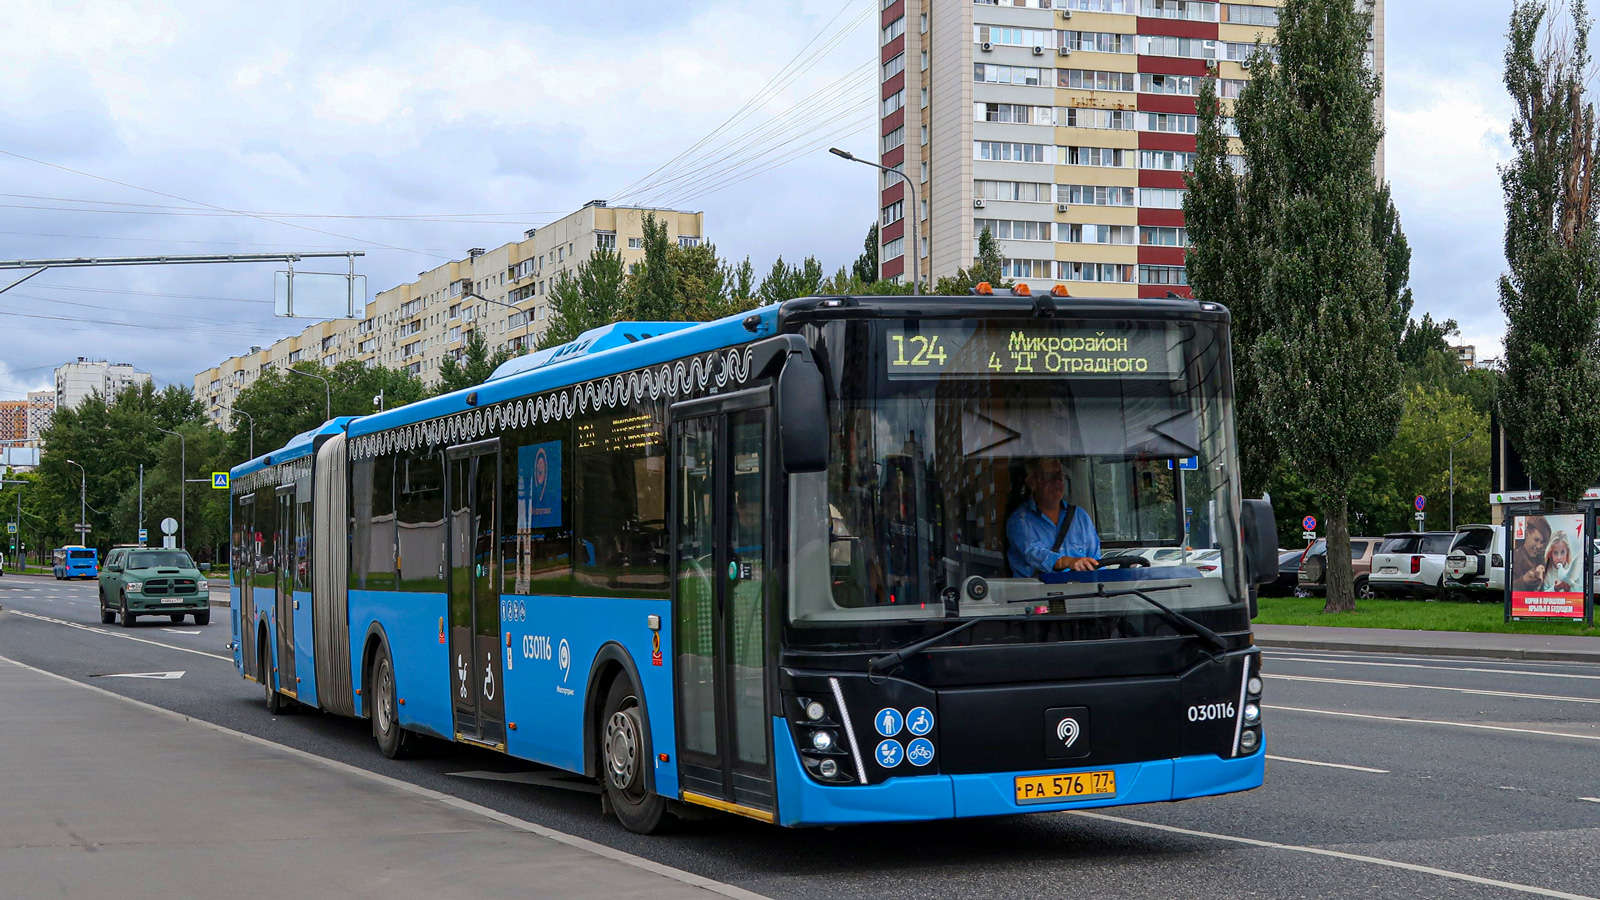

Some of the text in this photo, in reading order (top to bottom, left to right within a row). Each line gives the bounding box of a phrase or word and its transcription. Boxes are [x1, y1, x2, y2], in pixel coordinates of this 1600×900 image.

[892, 334, 948, 366] 124
[1008, 331, 1128, 352] Микрорайон
[988, 351, 1148, 373] 4 "Д" Отрадного
[523, 635, 551, 660] 030116
[1187, 701, 1235, 722] 030116
[1053, 776, 1084, 795] 576
[1093, 773, 1109, 788] 77
